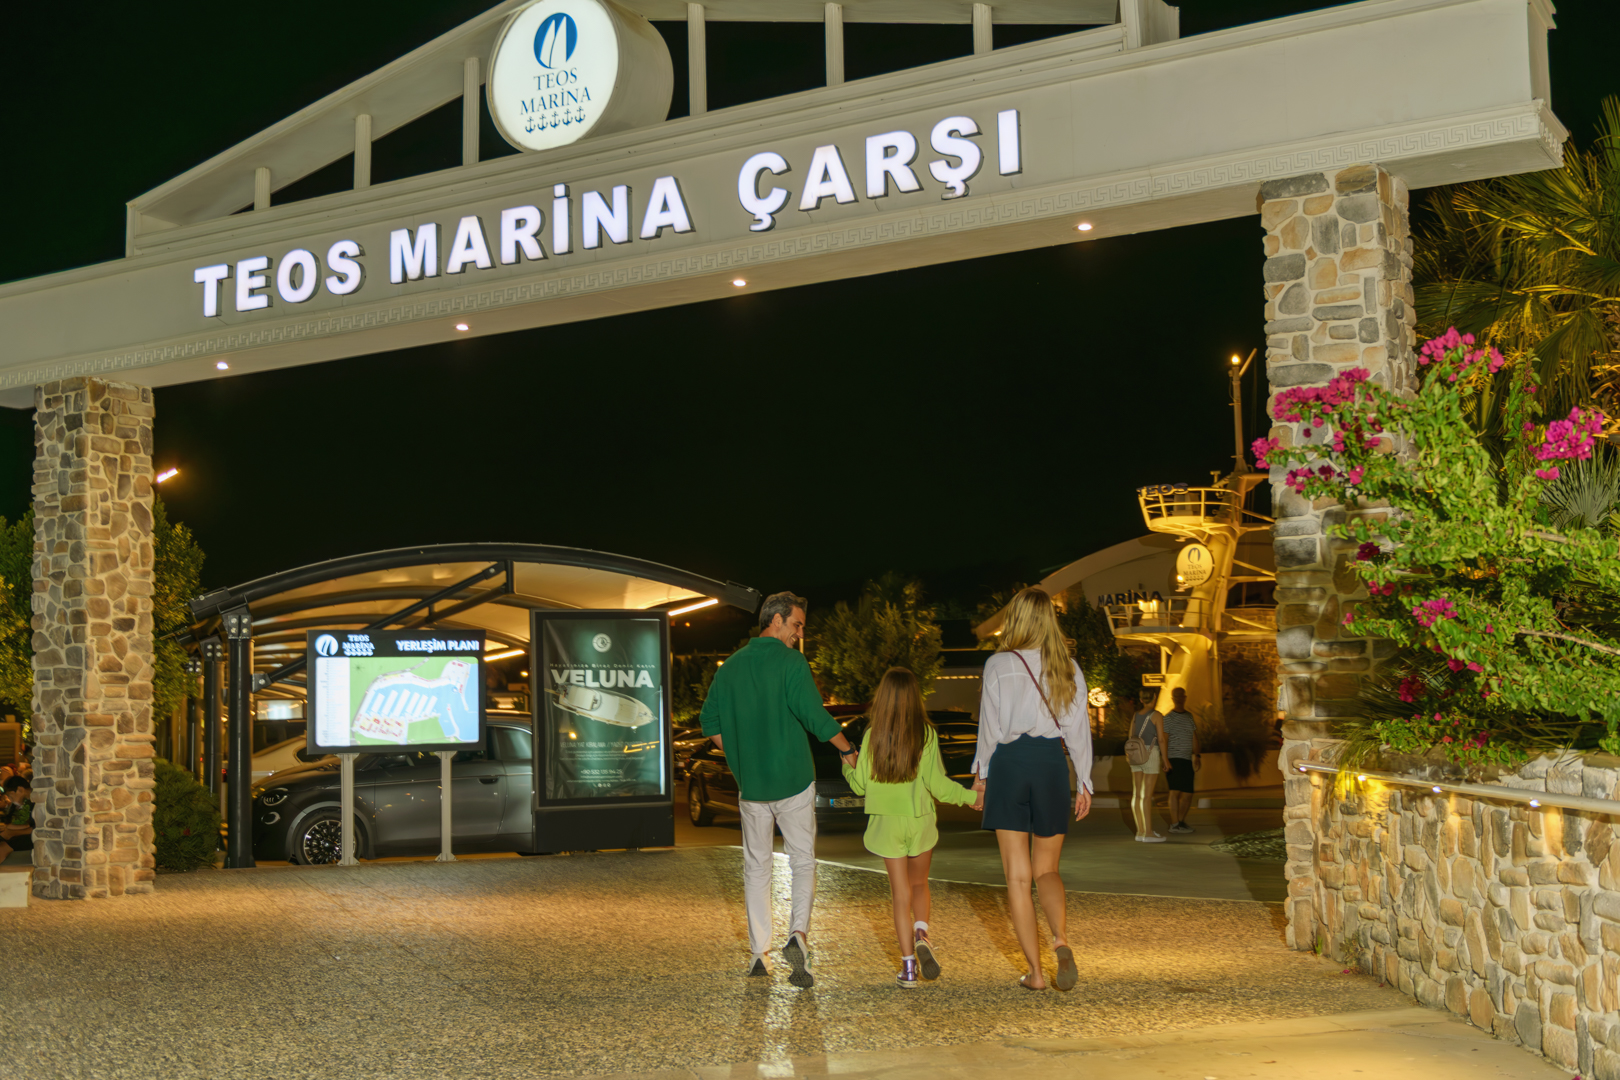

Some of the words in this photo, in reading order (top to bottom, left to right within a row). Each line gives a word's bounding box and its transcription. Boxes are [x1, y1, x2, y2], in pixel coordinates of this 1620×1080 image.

[533, 67, 578, 91] TEOS
[519, 86, 592, 116] MARİNA
[194, 239, 366, 318] TEOS
[389, 175, 696, 285] MARİNA
[737, 108, 1023, 233] ÇARŞI
[342, 642, 375, 650] MARİNA
[347, 634, 370, 642] TEOS
[396, 638, 447, 653] YERLEŞİM
[447, 640, 480, 651] PLANI
[551, 669, 655, 689] VELUNA
